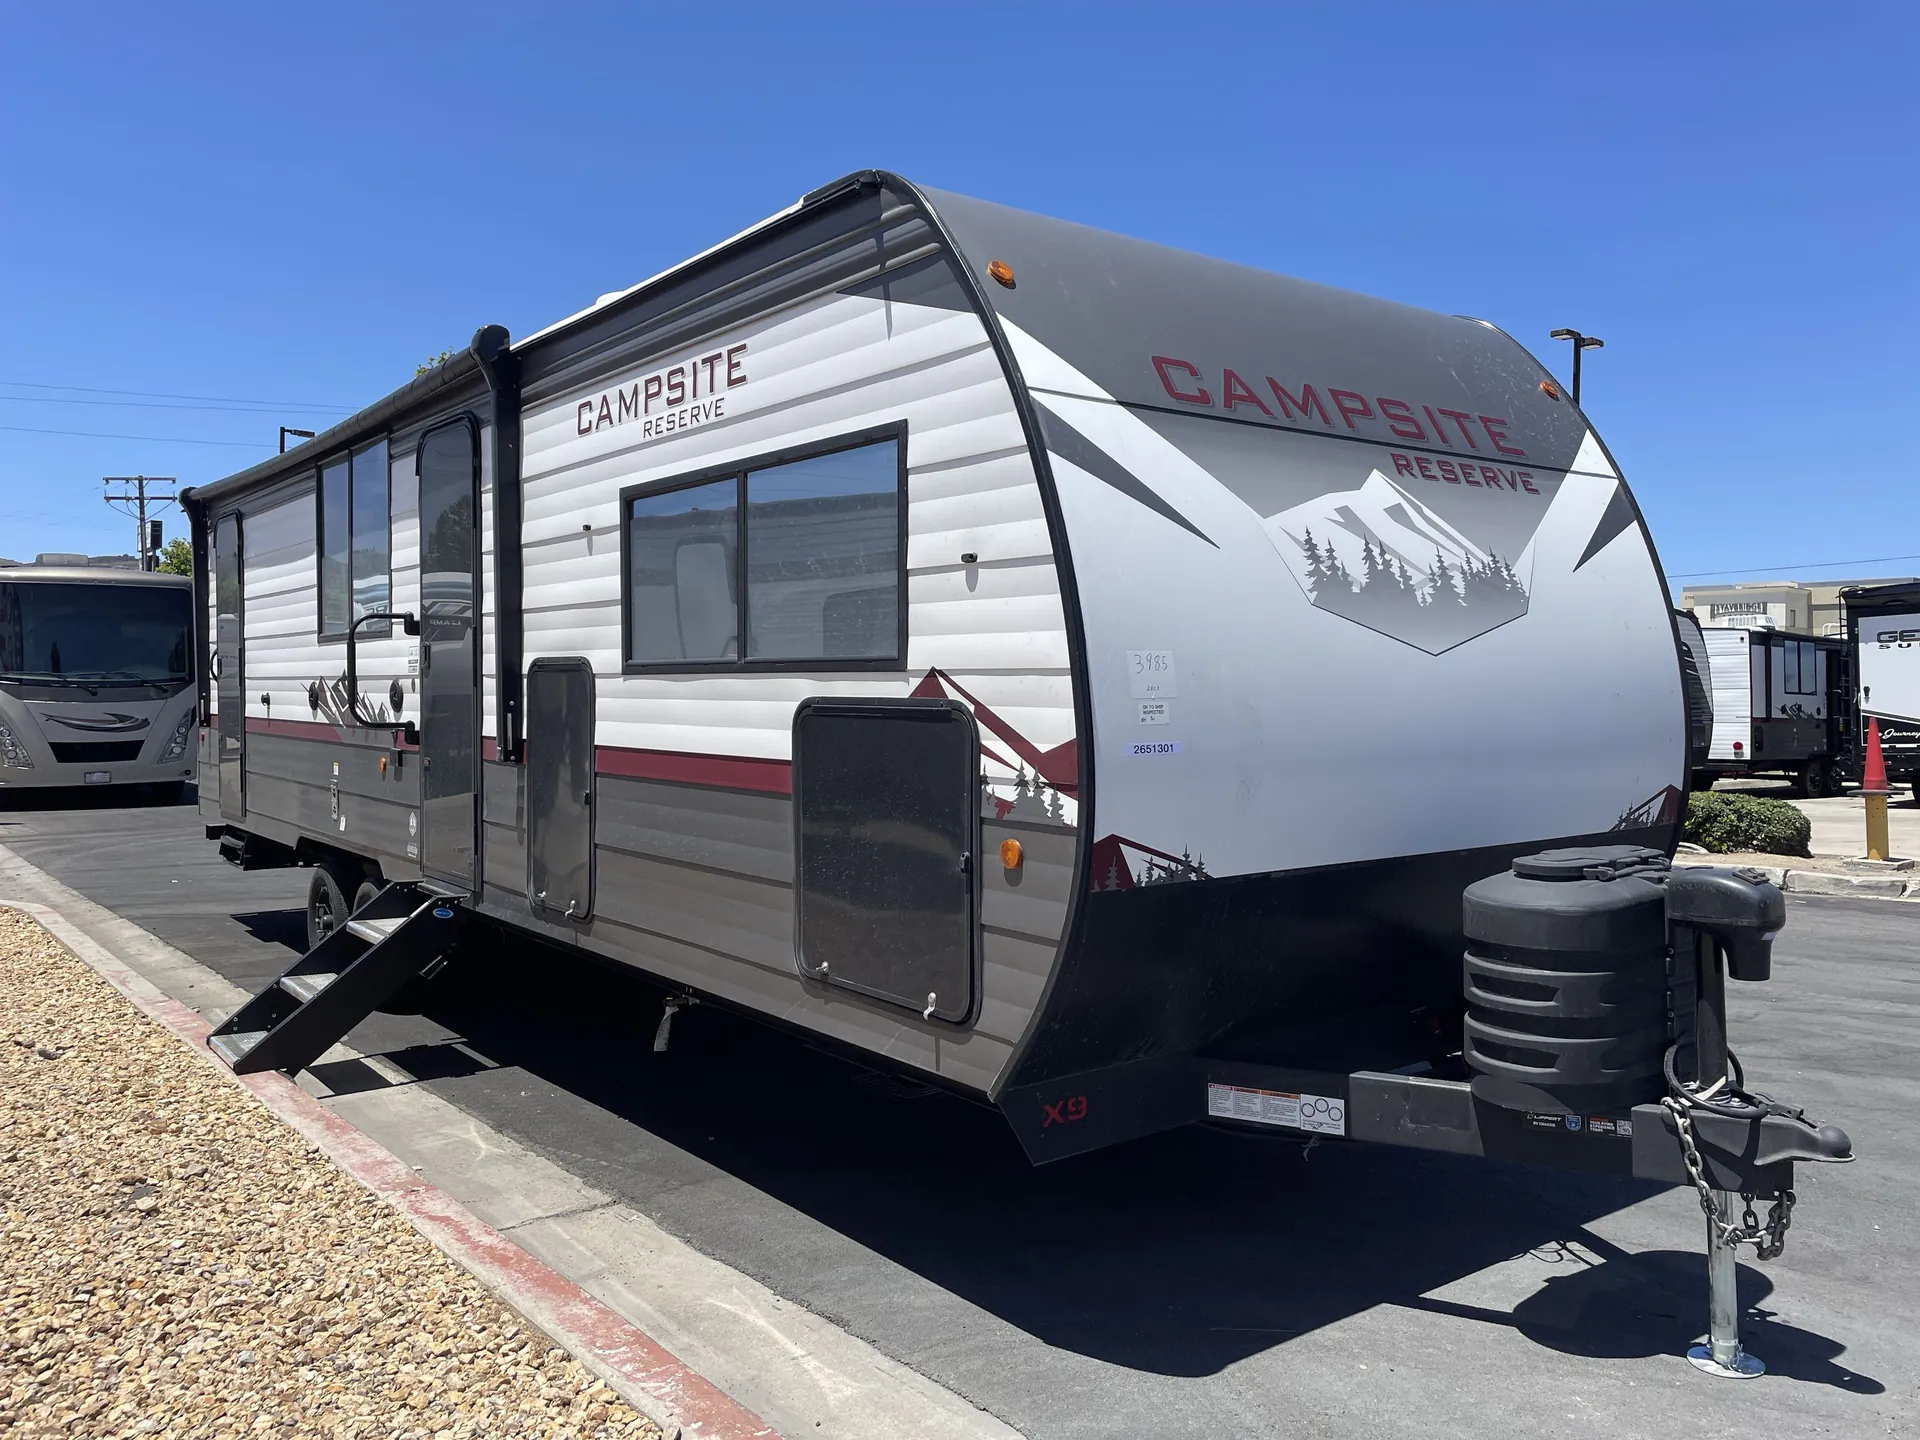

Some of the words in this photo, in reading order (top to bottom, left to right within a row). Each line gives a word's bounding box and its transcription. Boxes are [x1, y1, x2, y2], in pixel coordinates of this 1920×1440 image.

[577, 343, 748, 437] CAMPSITE
[1151, 355, 1526, 456] CAMPSITE
[643, 397, 726, 439] RESERVE
[1389, 452, 1541, 494] RESERVE
[1134, 653, 1168, 674] 3985
[1133, 743, 1174, 754] 2651301
[1043, 1096, 1087, 1128] X9
